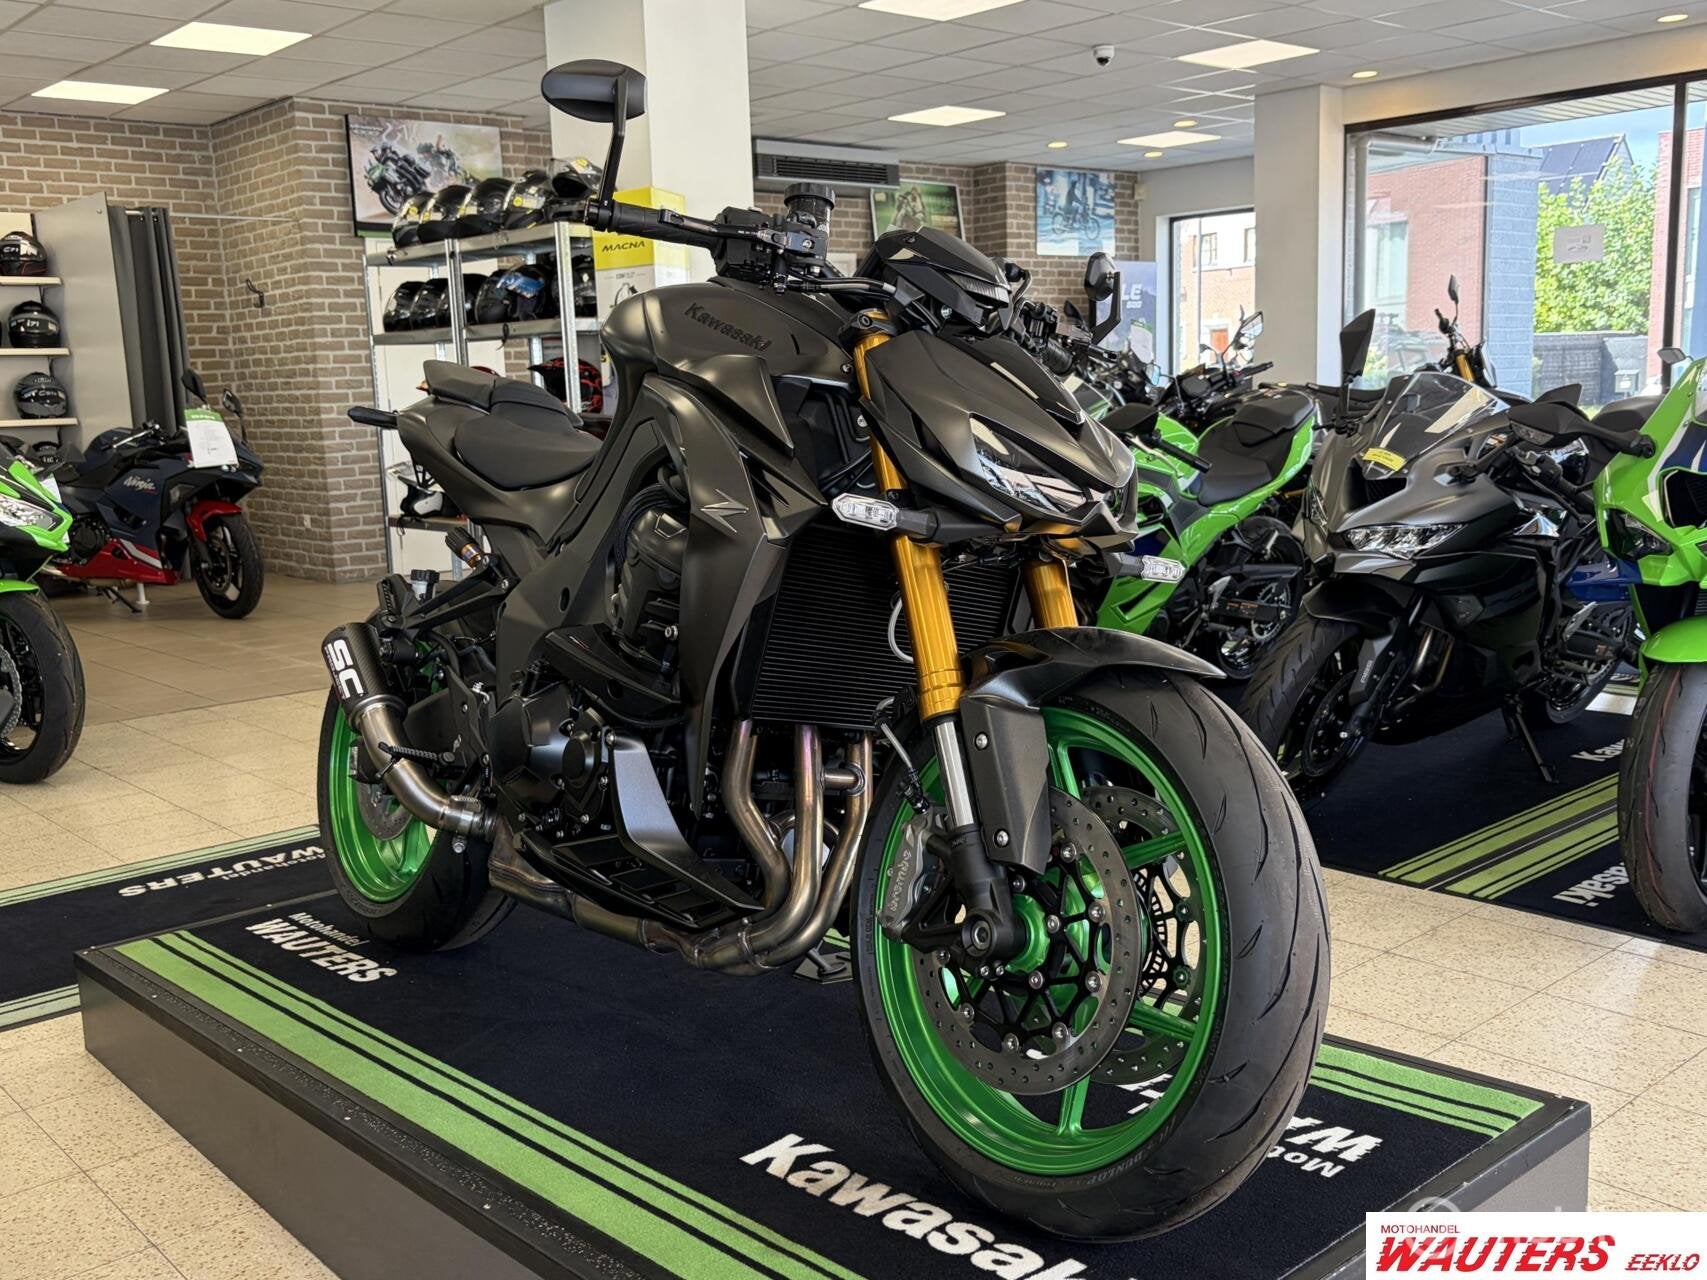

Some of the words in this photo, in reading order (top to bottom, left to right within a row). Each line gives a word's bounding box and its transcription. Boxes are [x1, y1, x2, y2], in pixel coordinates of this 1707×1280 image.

[602, 240, 646, 252] MACNA
[684, 302, 772, 351] Kawasaki
[123, 475, 156, 490] Ninja
[326, 638, 365, 699] SC
[118, 846, 326, 897] WAUTERS
[245, 918, 398, 982] WAUTERS
[288, 912, 371, 947] Motohandel
